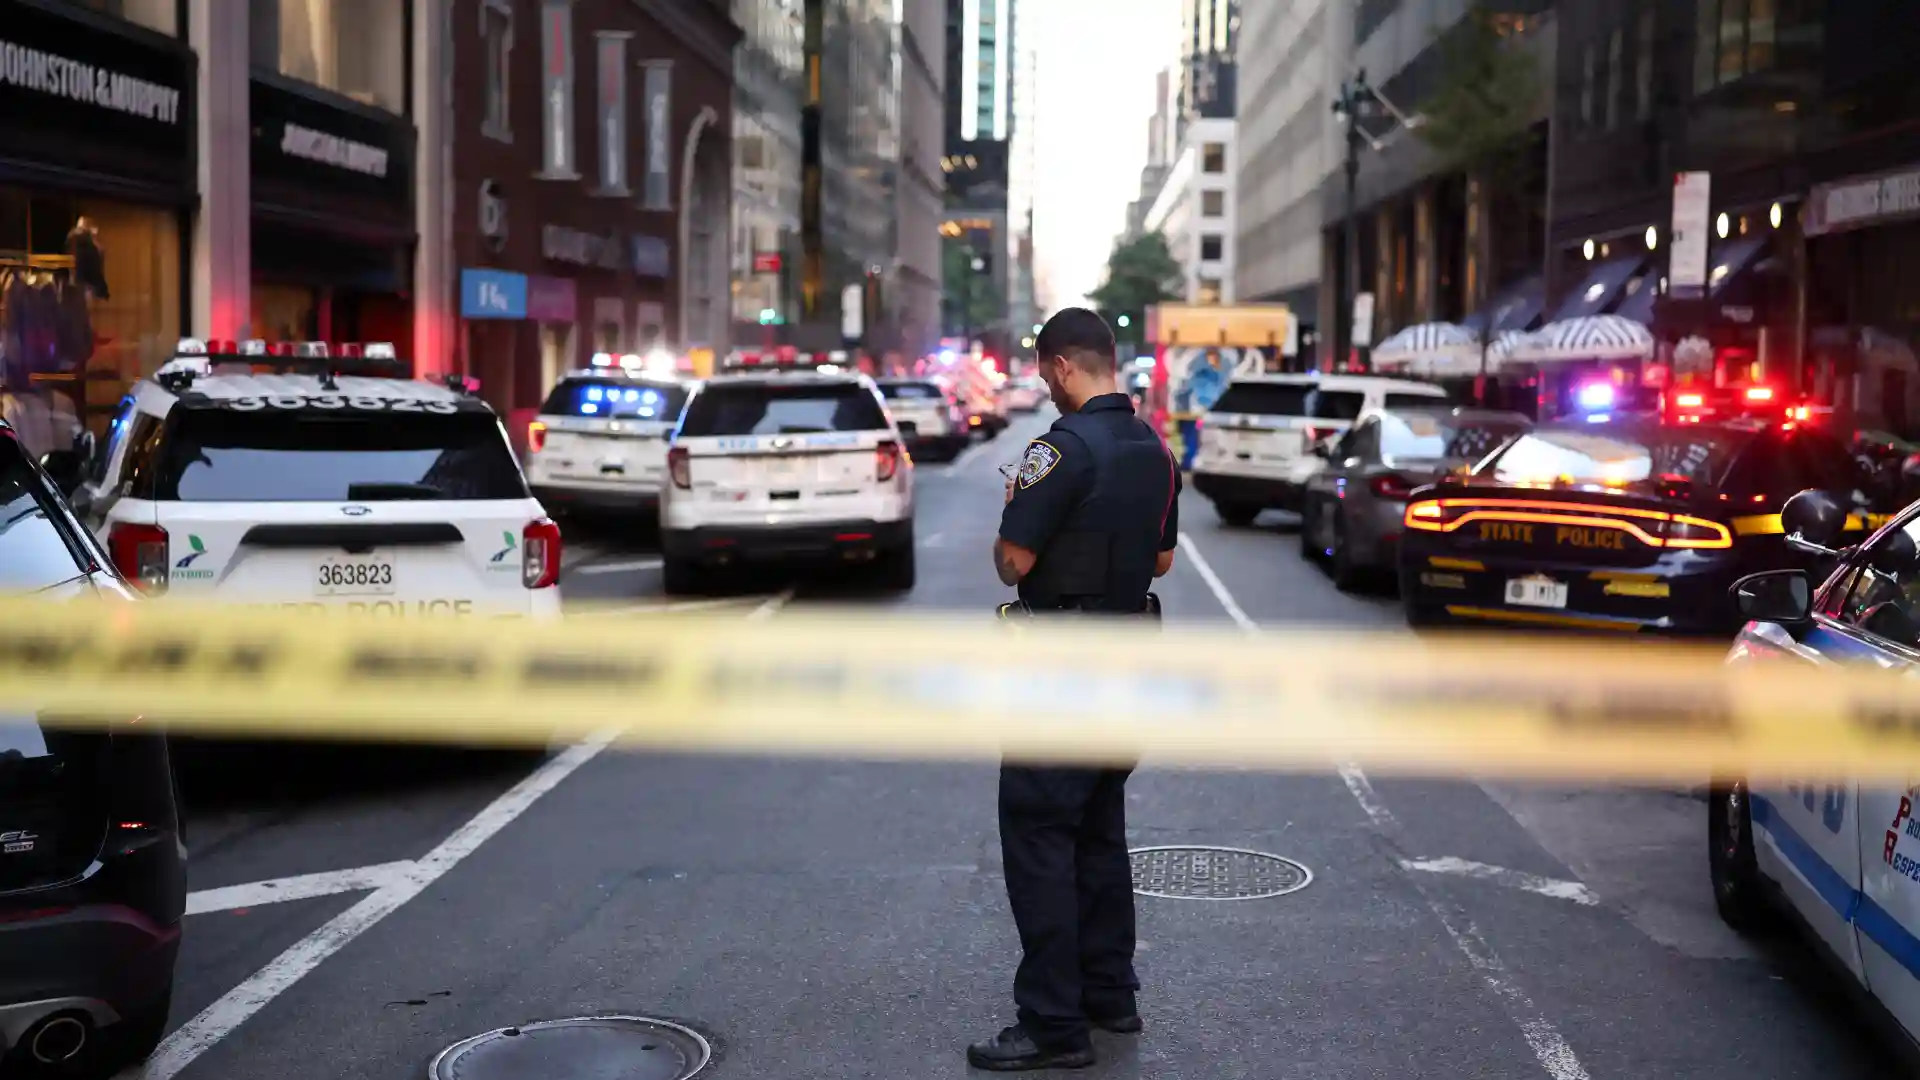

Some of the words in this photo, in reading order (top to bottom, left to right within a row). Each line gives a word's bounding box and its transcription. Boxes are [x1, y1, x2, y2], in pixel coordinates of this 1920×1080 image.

[1035, 443, 1052, 455] POLICE
[1479, 521, 1534, 544] STATE
[1556, 525, 1626, 549] POLICE
[171, 569, 214, 580] HYBRID
[318, 564, 392, 586] 363823
[1883, 829, 1920, 884] RESPE
